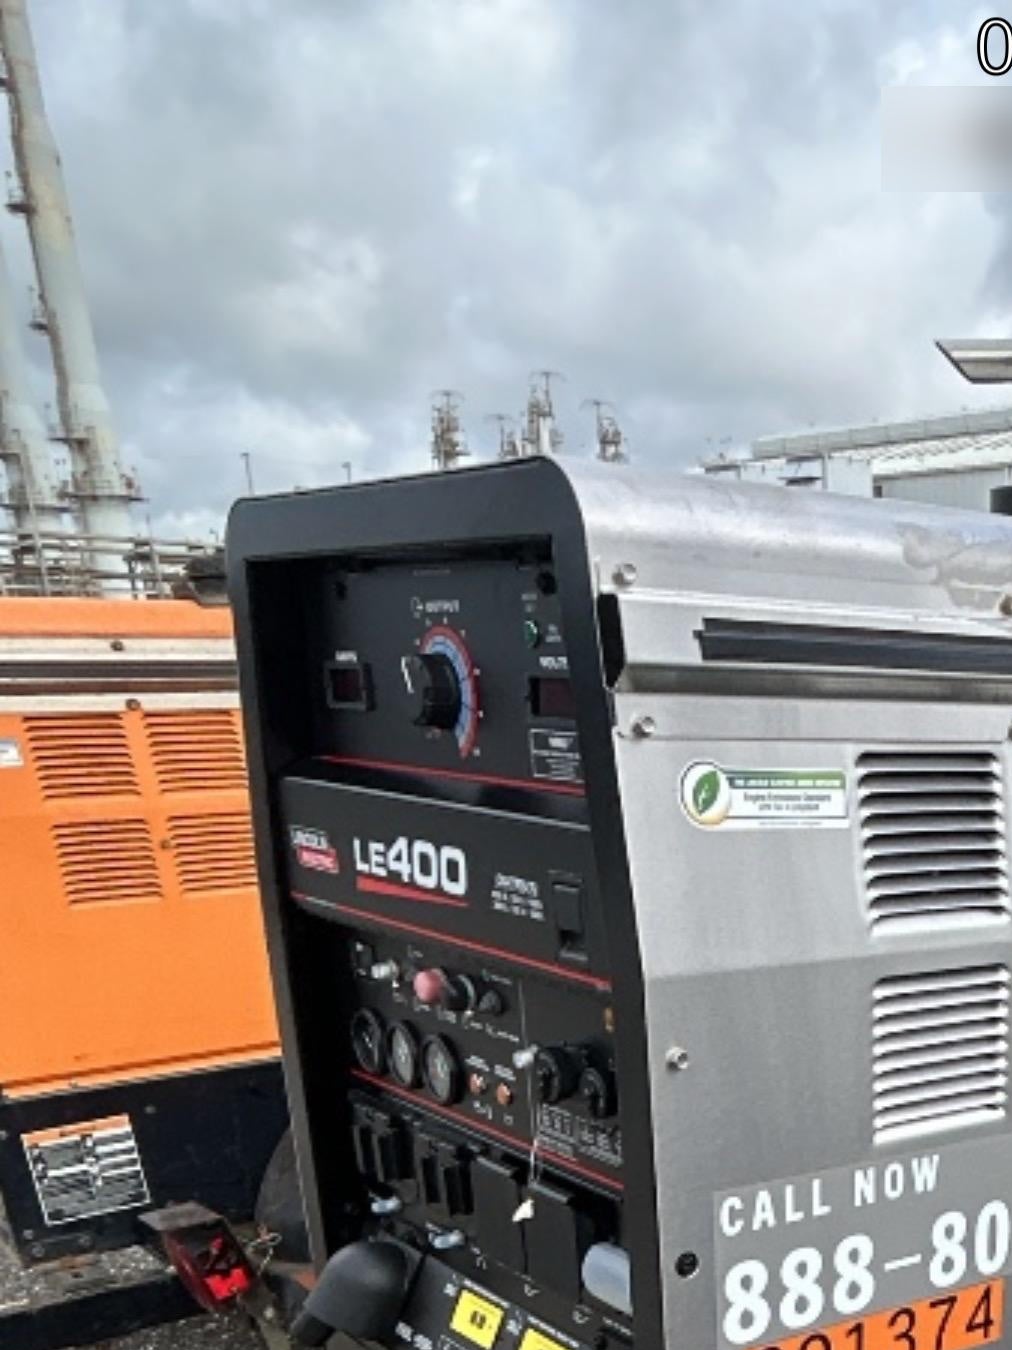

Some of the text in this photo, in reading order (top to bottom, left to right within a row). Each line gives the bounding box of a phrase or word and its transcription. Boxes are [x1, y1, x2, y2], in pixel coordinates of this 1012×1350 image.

[353, 836, 468, 897] LE400
[719, 1154, 941, 1237] CALL NOW
